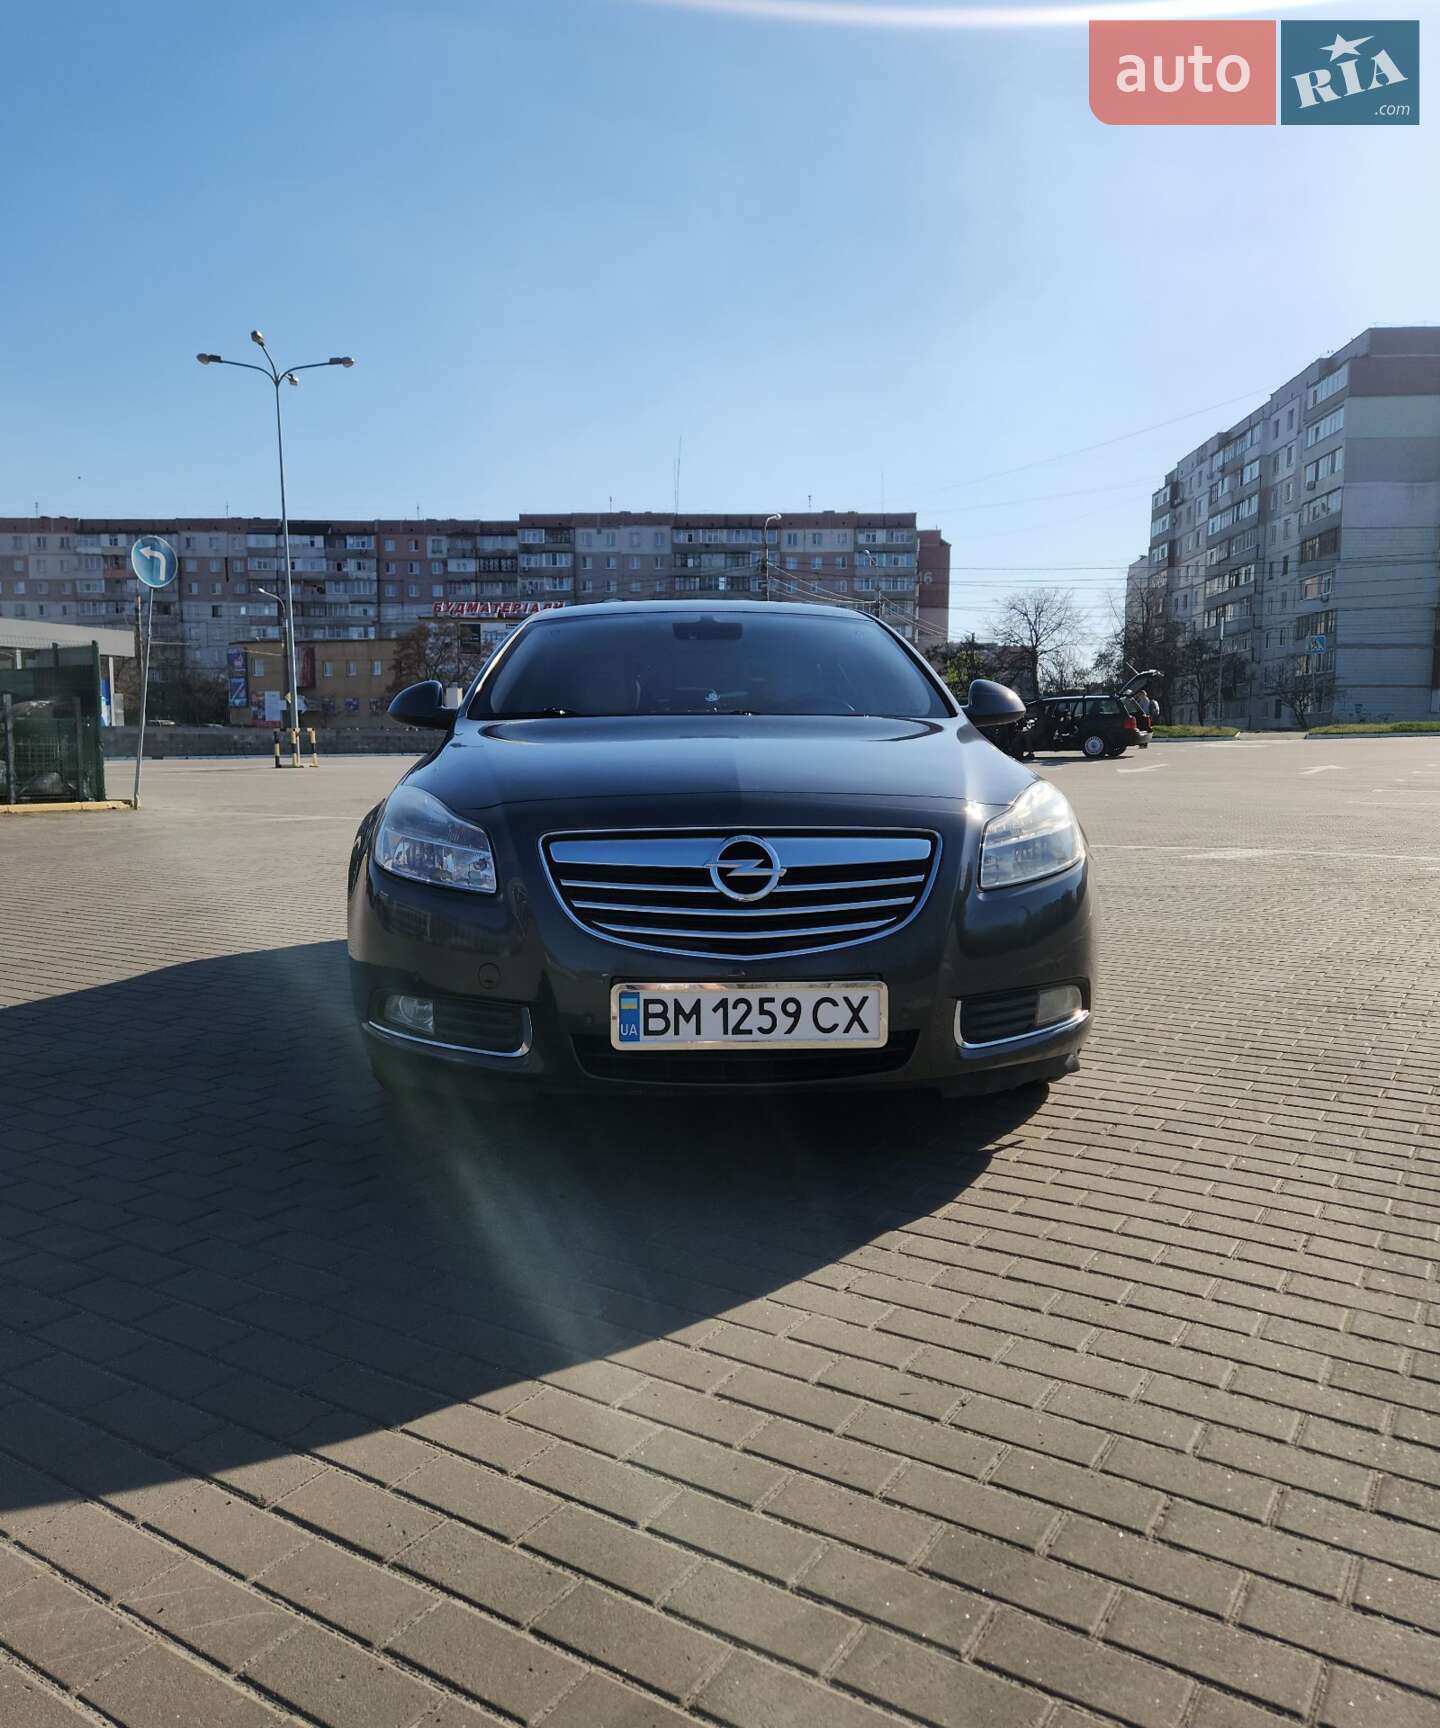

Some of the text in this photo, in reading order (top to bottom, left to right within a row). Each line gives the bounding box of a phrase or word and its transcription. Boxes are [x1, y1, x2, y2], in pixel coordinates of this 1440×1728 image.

[643, 996, 869, 1036] BM 1259 CX
[620, 1023, 638, 1036] UA
